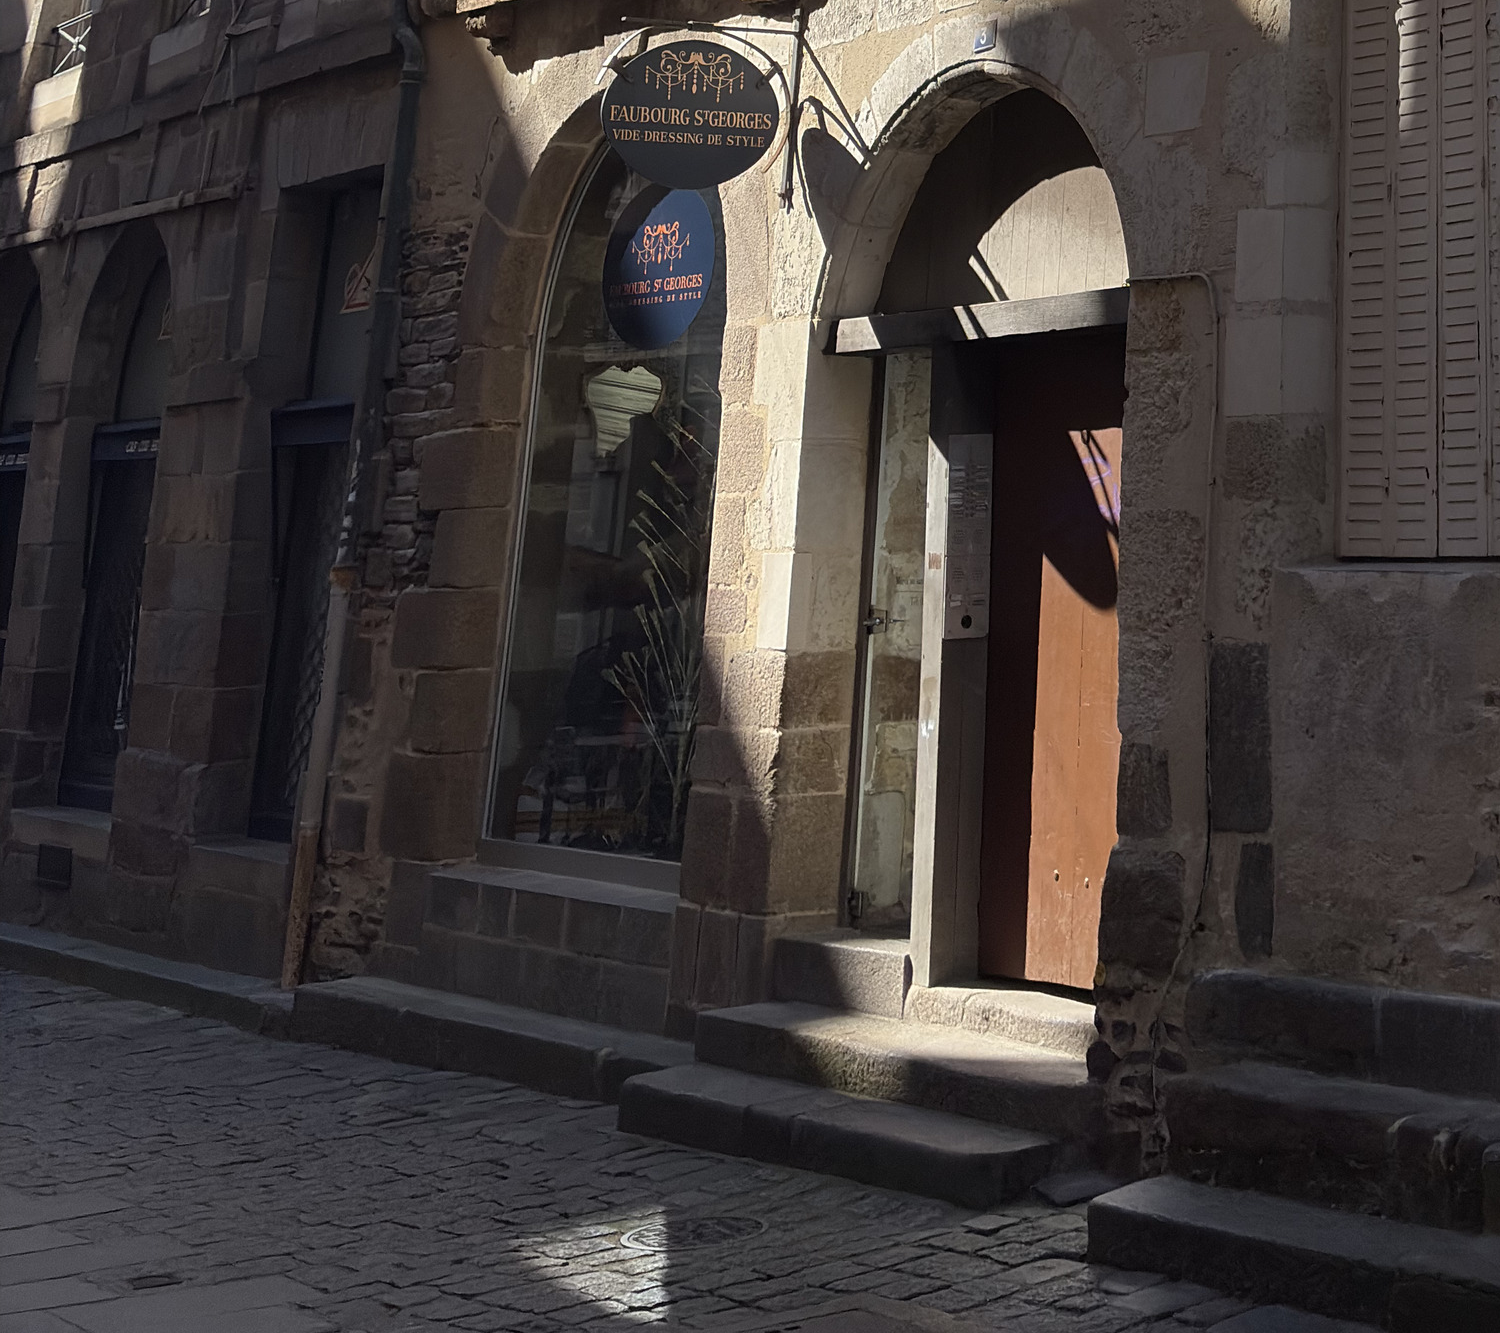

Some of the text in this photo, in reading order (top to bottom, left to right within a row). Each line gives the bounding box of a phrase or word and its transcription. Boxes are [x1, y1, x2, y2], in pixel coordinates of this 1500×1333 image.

[609, 104, 691, 127] FAUBOURG
[613, 128, 766, 148] VIDE-DRESSING DE STYLE
[664, 273, 703, 291] GEORGES
[679, 290, 702, 301] STYLE
